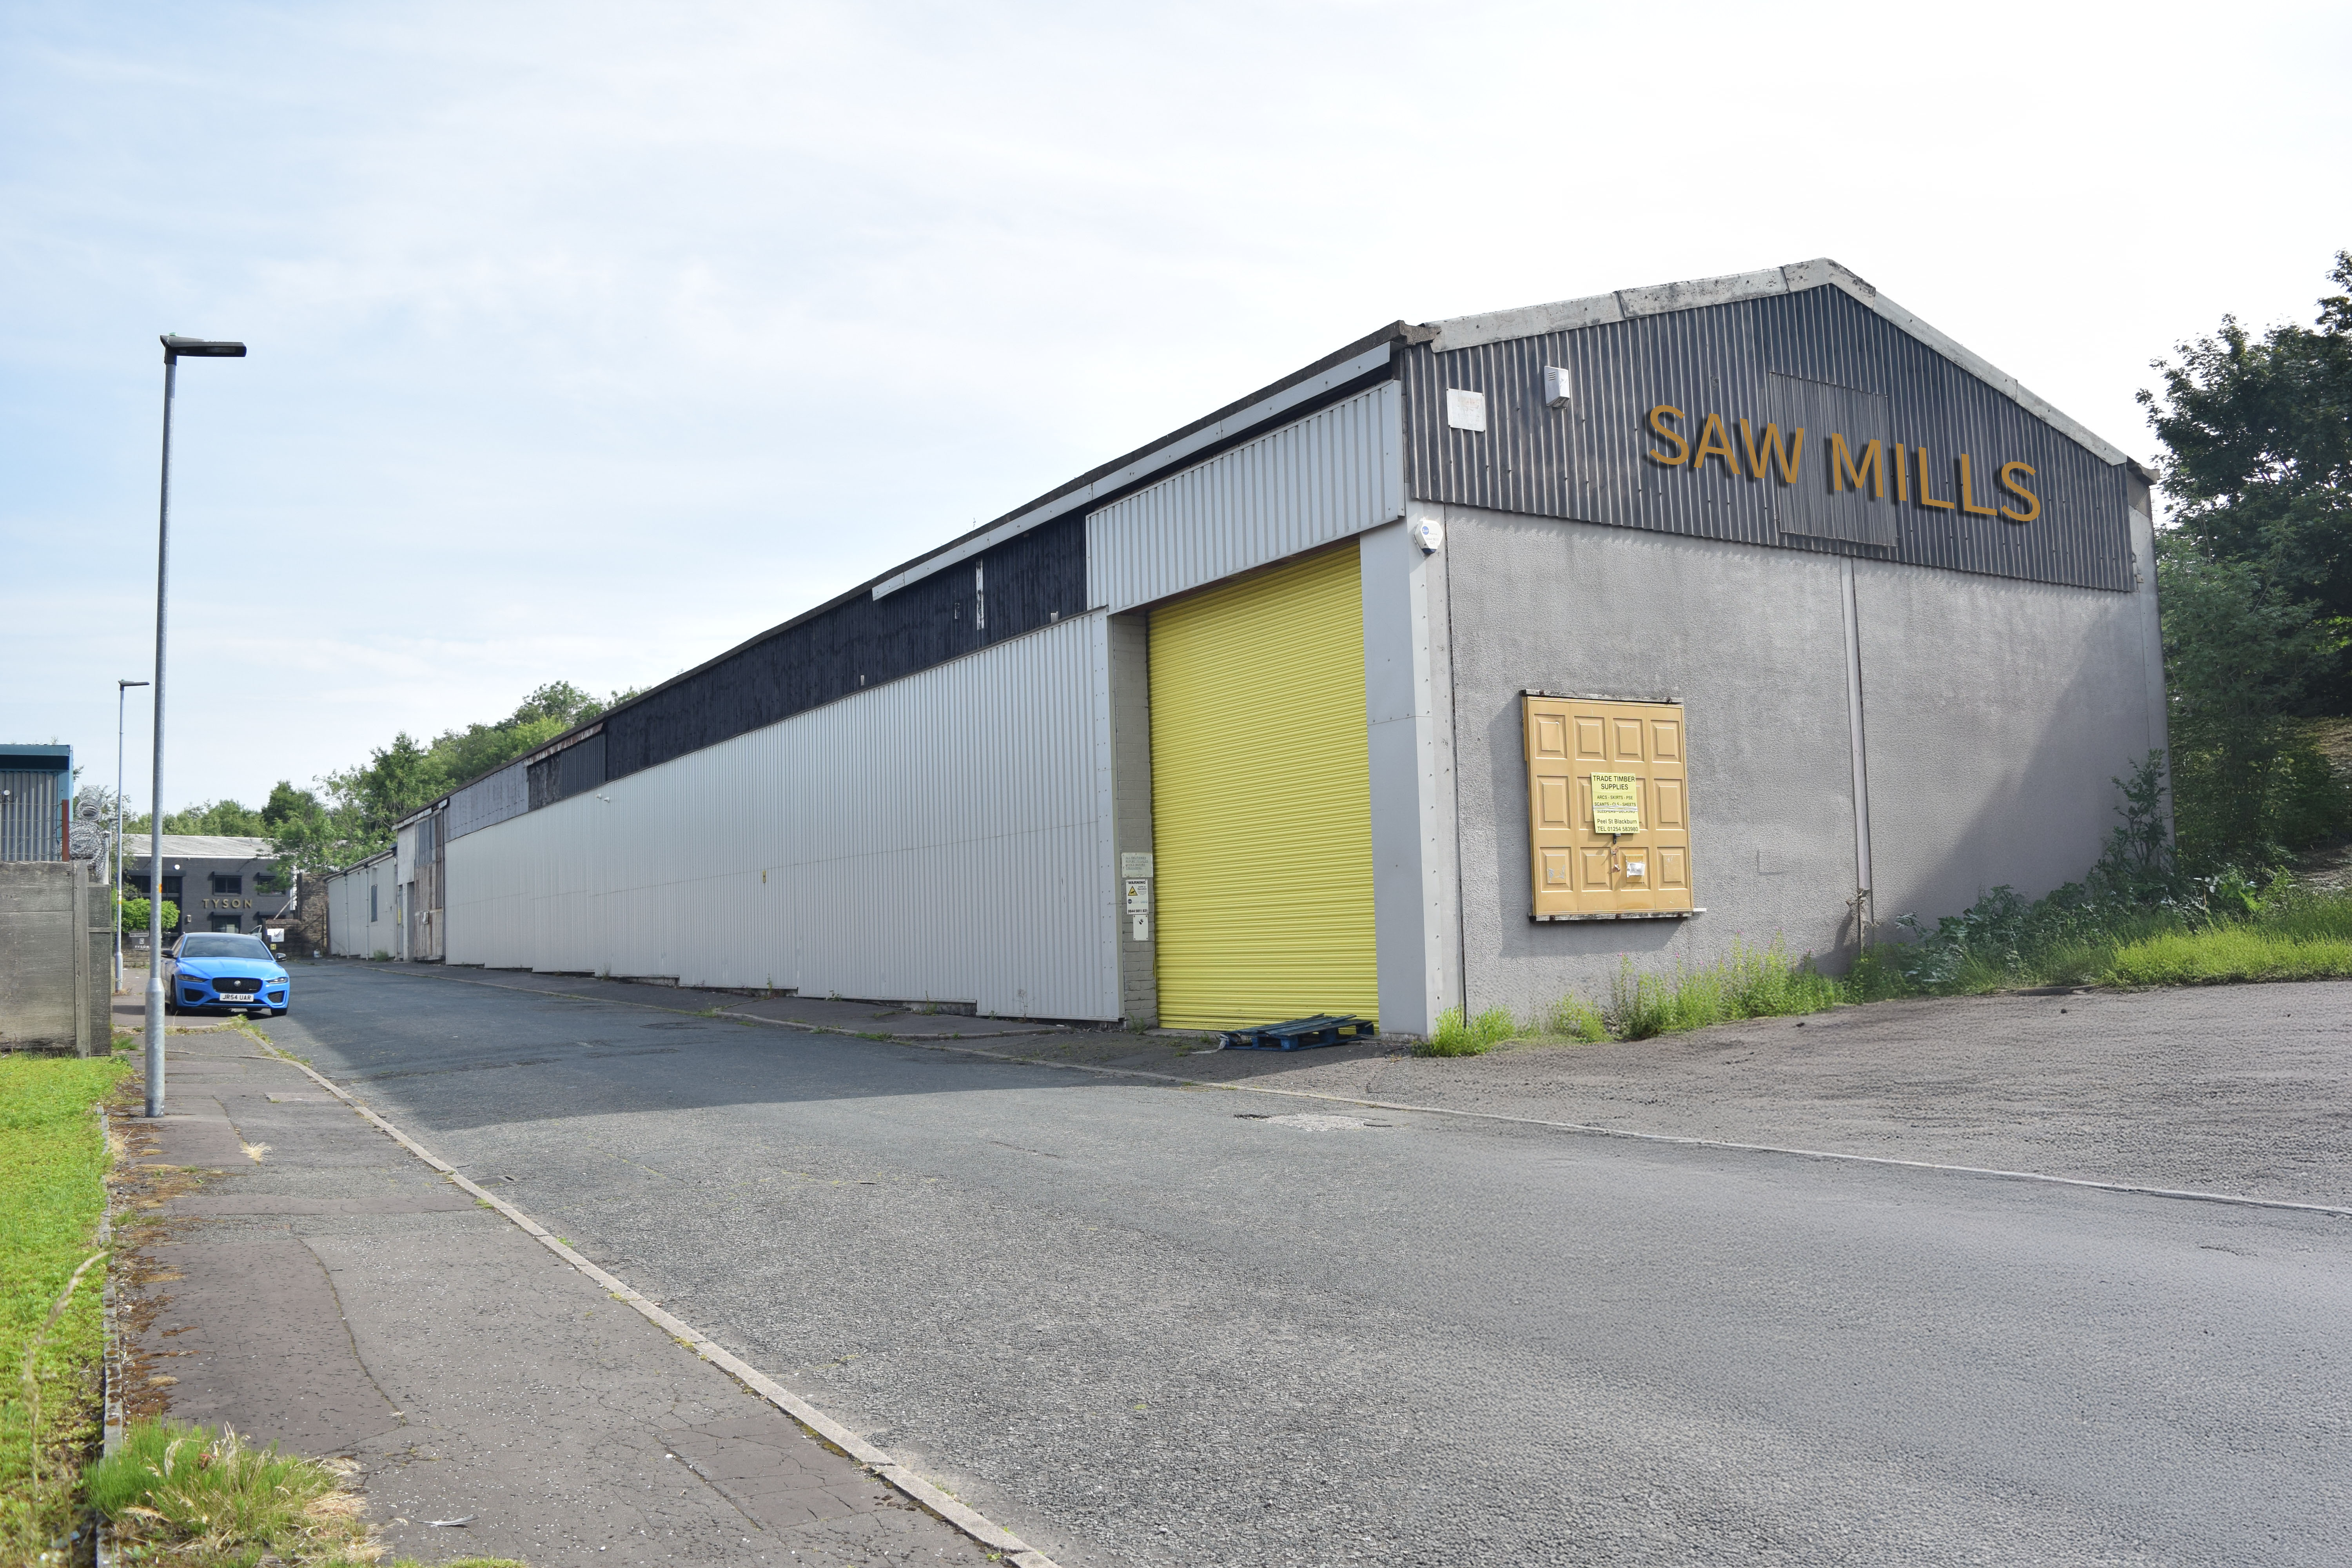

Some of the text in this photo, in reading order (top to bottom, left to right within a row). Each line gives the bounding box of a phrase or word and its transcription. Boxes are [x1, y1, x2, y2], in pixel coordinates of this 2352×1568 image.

[1649, 405, 2041, 522] SAW MILLS
[203, 899, 252, 908] TYSON
